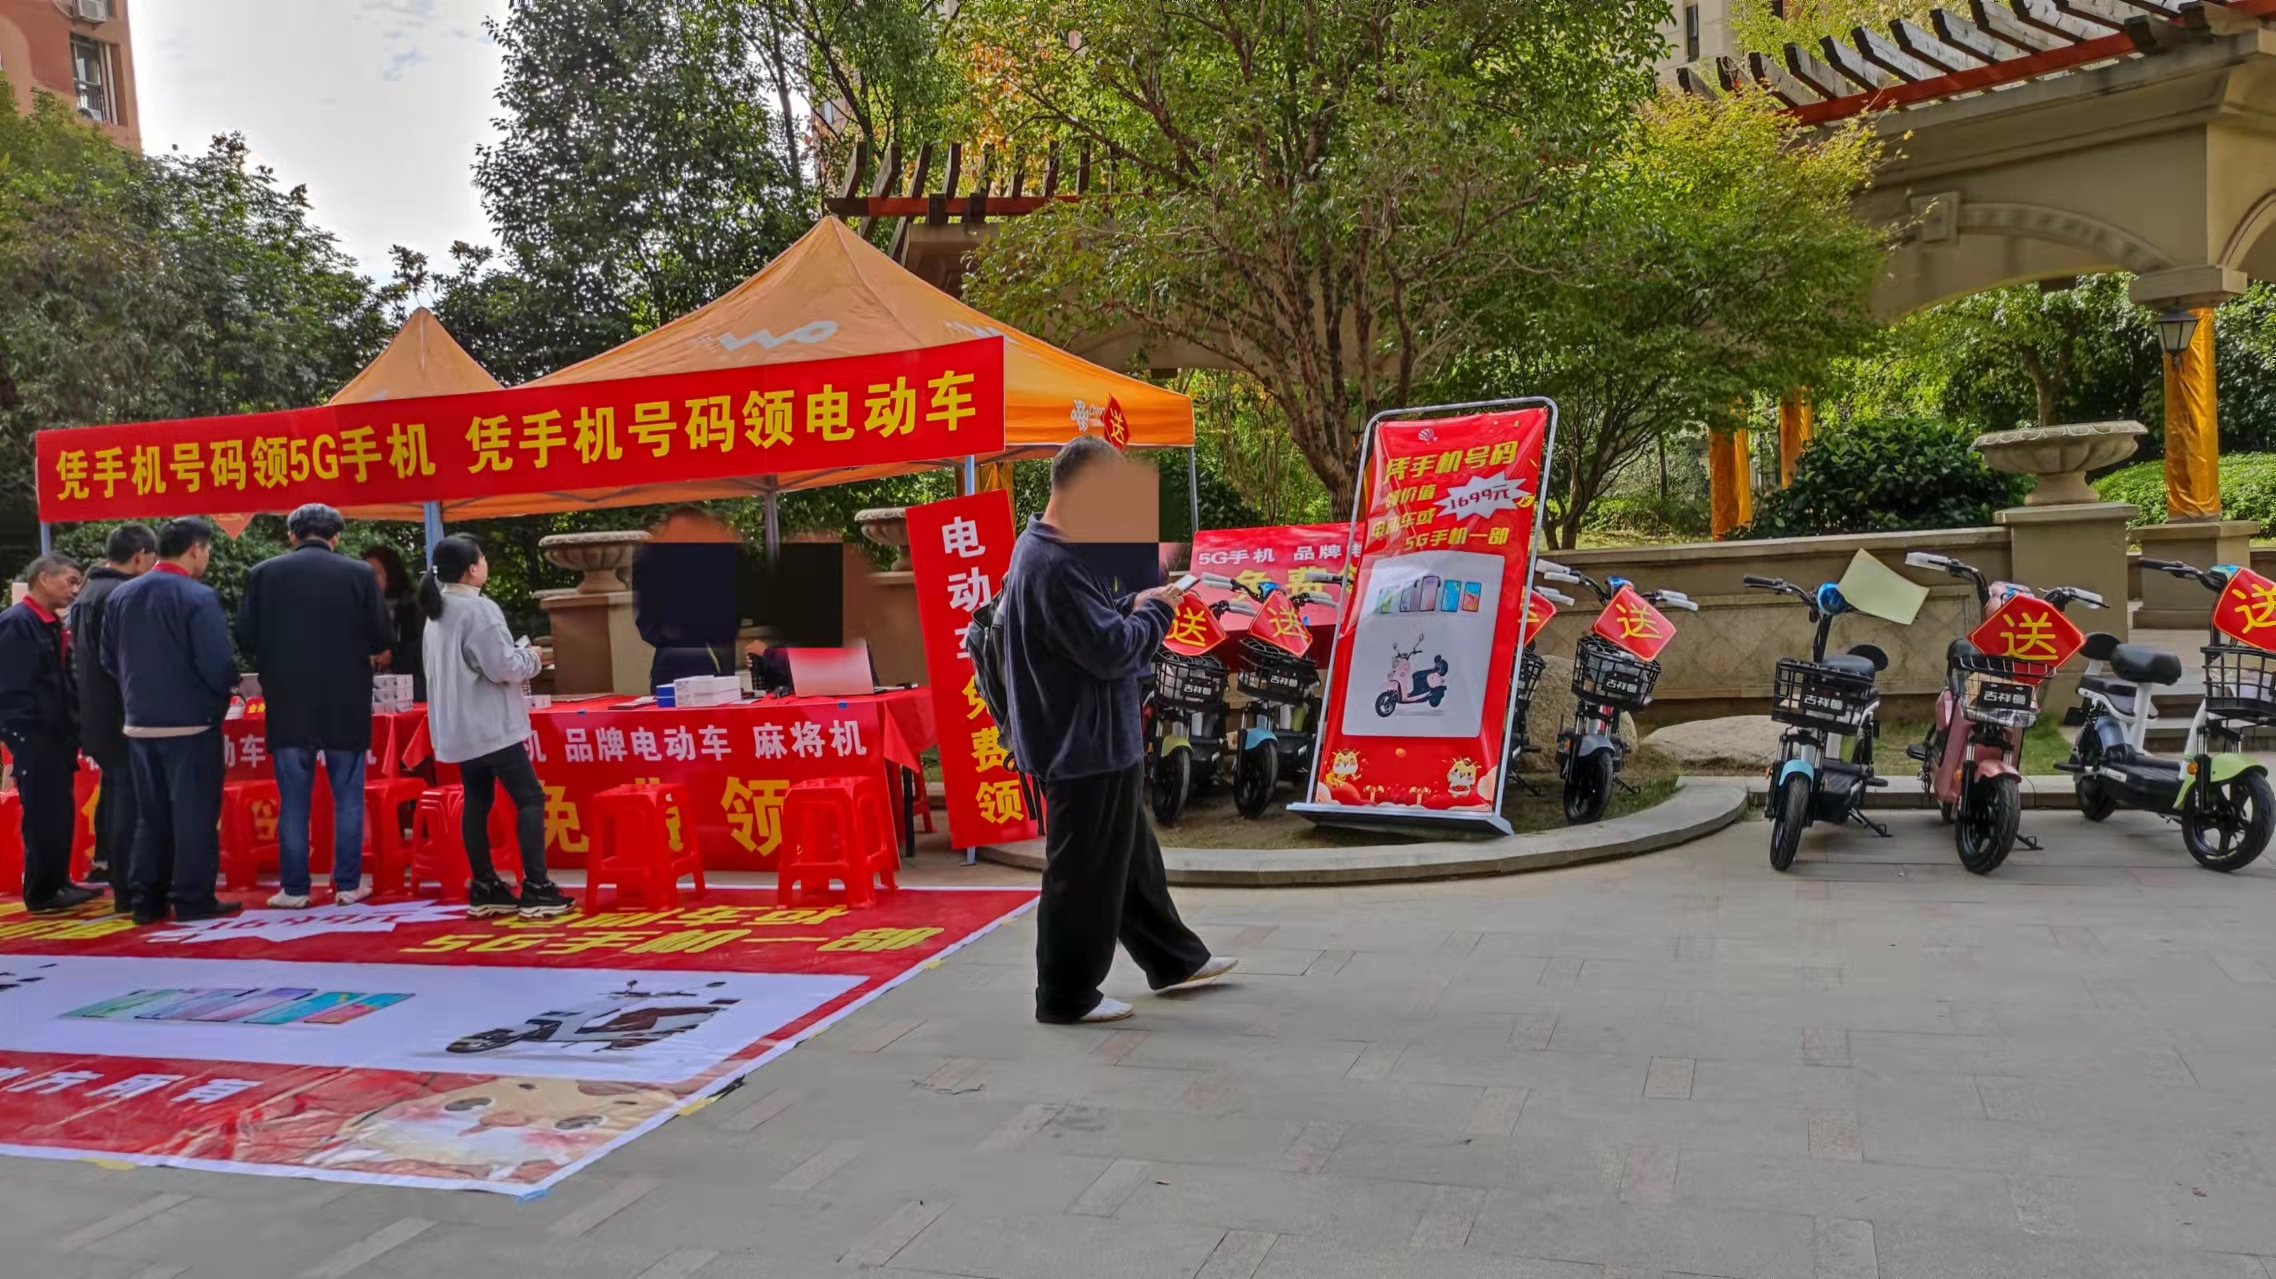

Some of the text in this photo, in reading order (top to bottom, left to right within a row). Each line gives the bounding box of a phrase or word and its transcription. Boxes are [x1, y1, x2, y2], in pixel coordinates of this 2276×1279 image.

[56, 370, 976, 500] 凭手机号码领5G手机 凭手机号码领电动车
[1383, 440, 1518, 484] 凭手机号码
[1450, 484, 1511, 511] 1699元
[1199, 548, 1275, 565] 5G手机
[1405, 527, 1510, 550] 5G手机一部
[1225, 566, 1353, 603] 免费
[1166, 607, 1207, 647] 送
[1267, 605, 1310, 640] 送
[1616, 602, 1663, 639] 送
[2000, 612, 2059, 660] 送
[565, 722, 732, 763] 品牌电动车
[753, 720, 867, 760] 麻将机
[544, 776, 790, 856] 免领
[400, 927, 945, 954] 5G手机一部
